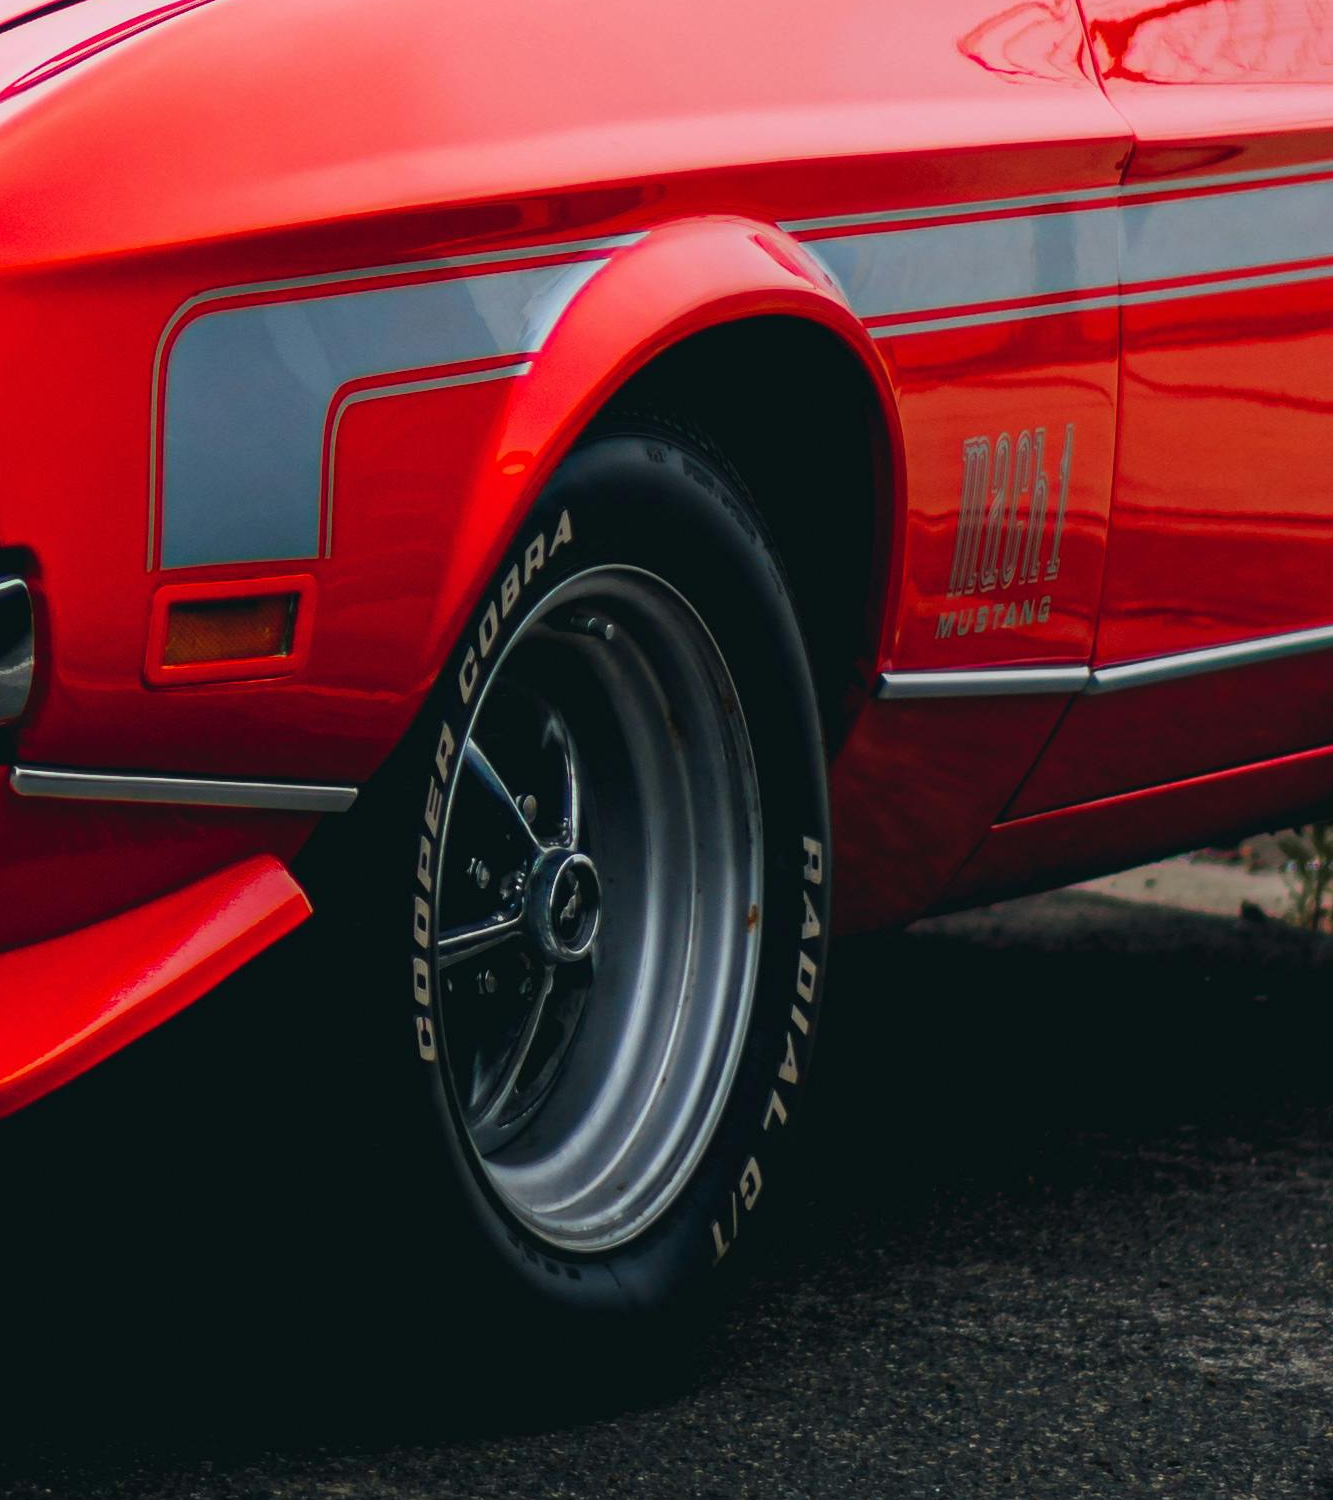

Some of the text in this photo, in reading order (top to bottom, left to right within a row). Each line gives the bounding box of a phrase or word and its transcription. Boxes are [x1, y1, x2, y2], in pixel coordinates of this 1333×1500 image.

[934, 596, 1052, 640] MUSTANG
[413, 509, 573, 1062] COOPER COBRA
[763, 836, 823, 1131] RADIAL
